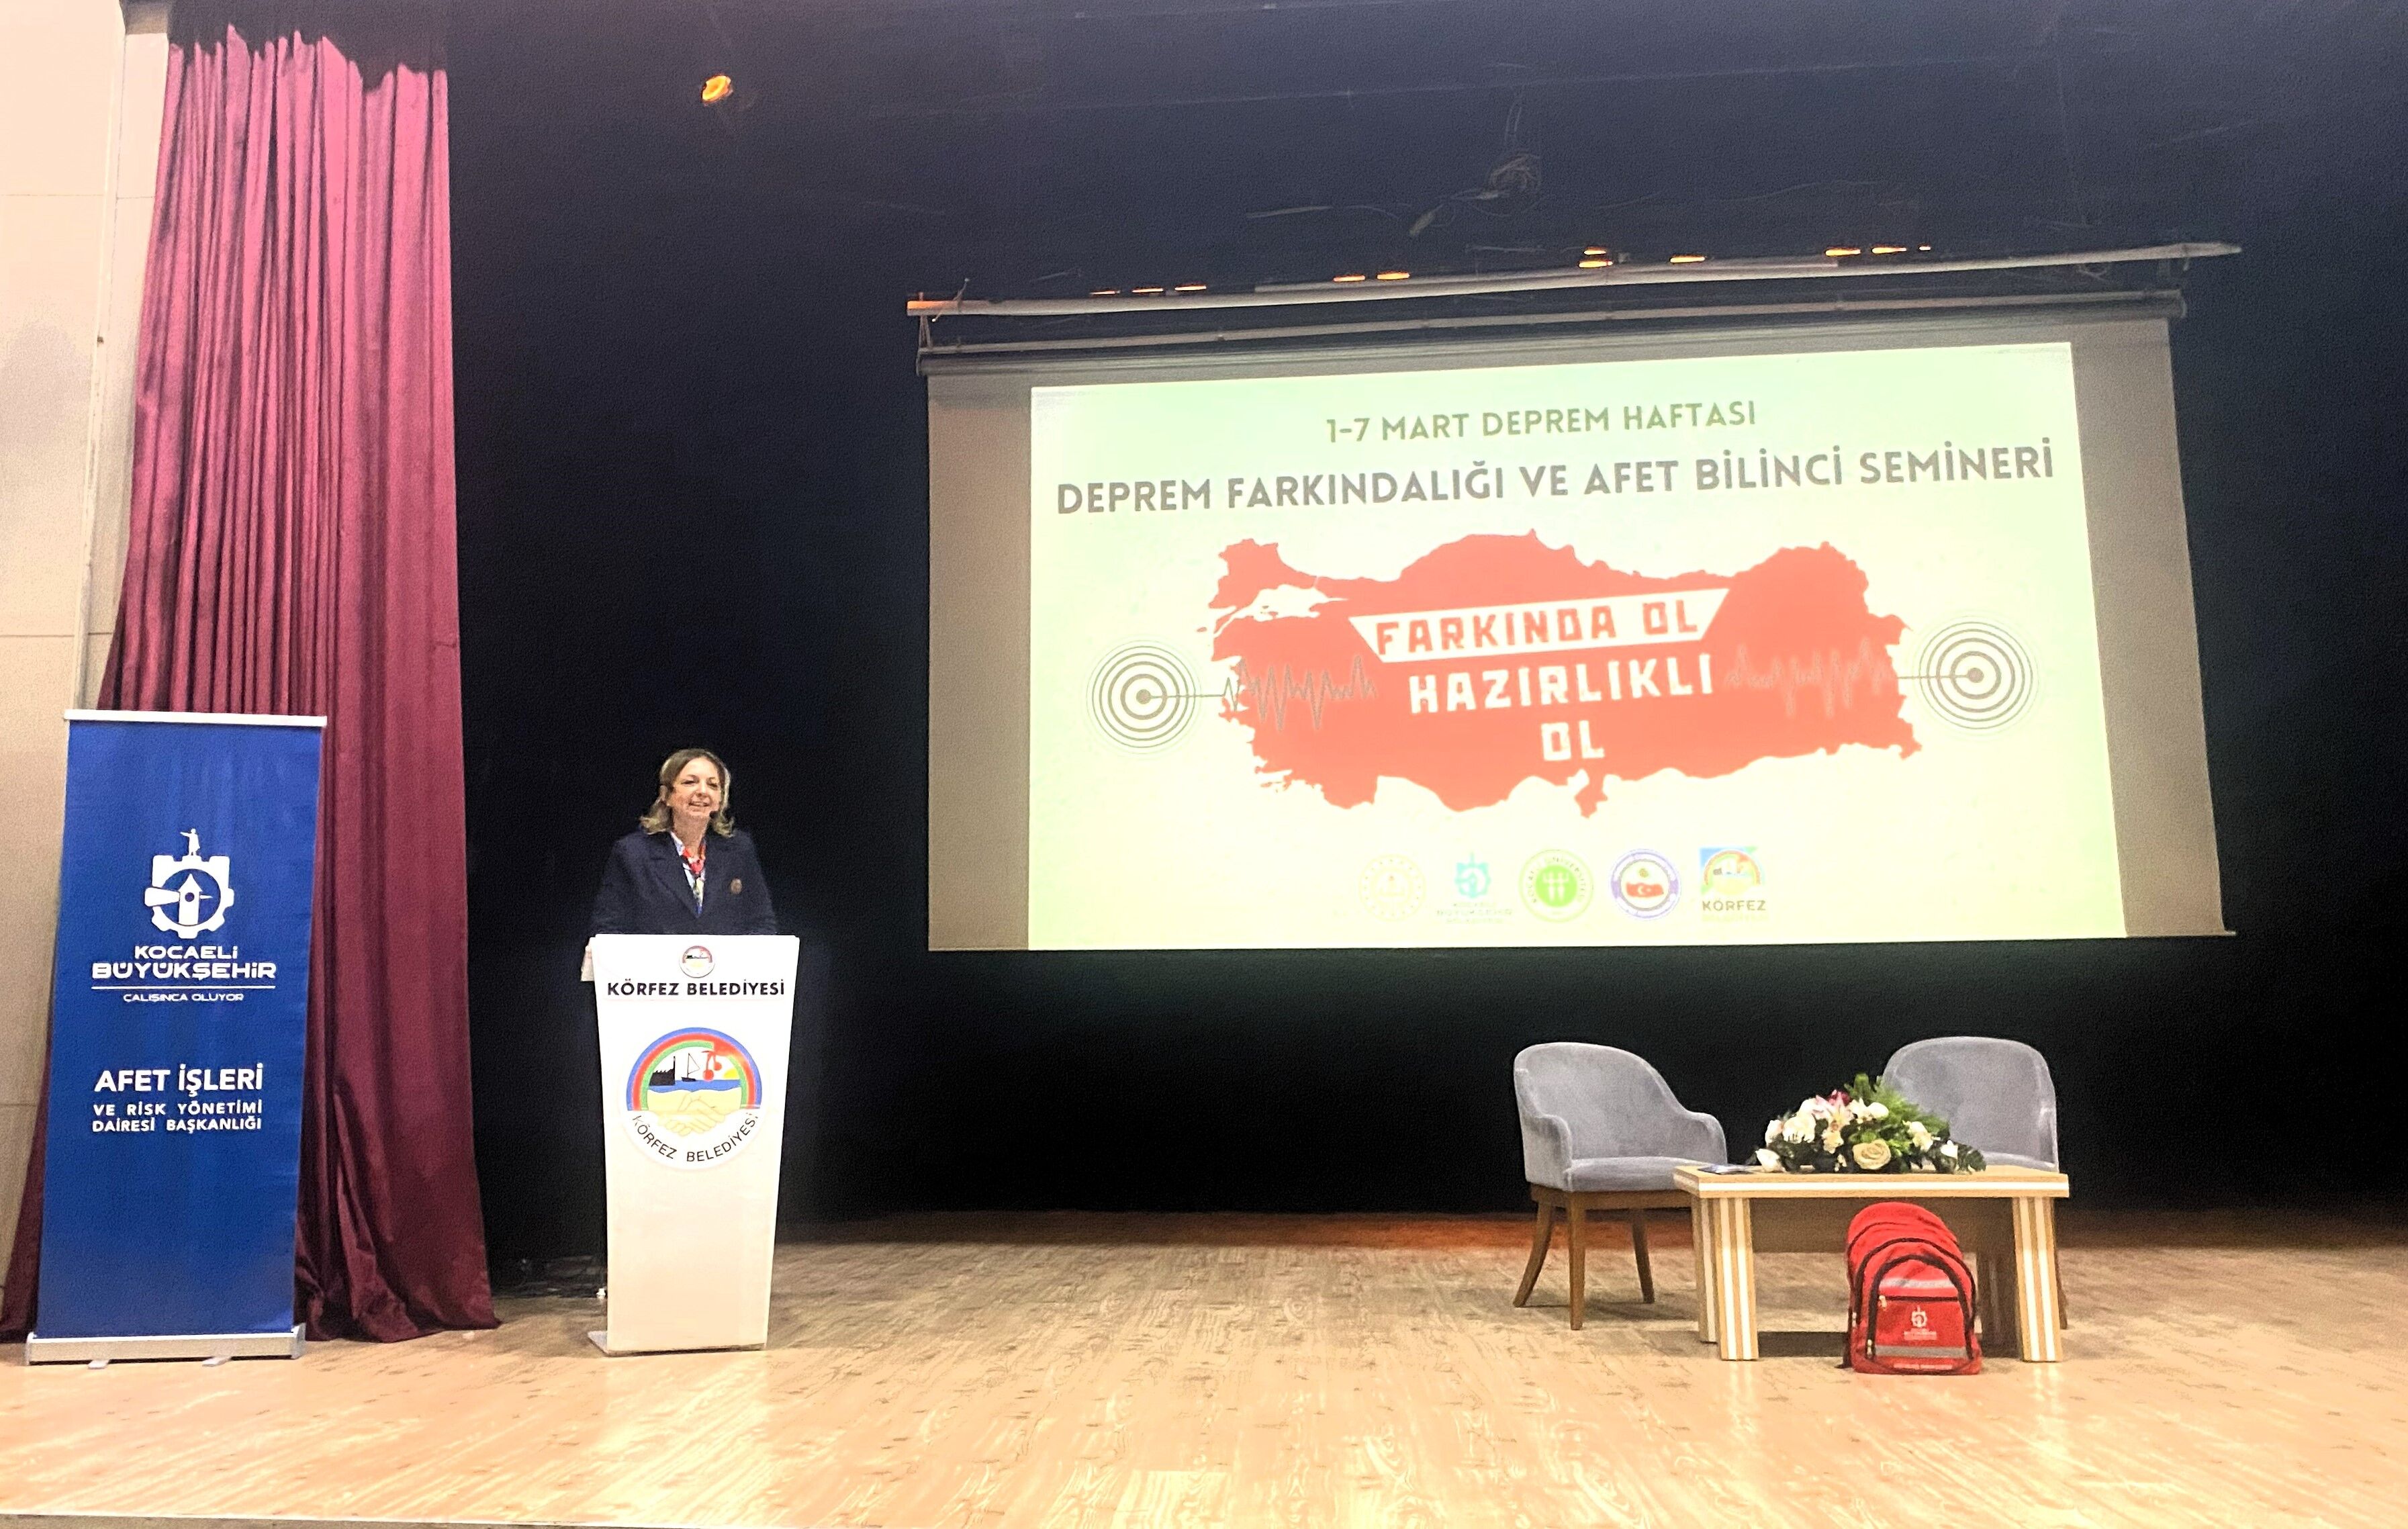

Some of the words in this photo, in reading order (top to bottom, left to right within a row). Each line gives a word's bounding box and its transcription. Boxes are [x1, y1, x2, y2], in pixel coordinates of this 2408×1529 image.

[1326, 417, 1371, 443] 1-7
[1381, 412, 1470, 441] MART
[1482, 406, 1610, 436] DEPREM
[1622, 400, 1757, 430] HAFTASI
[1057, 479, 1211, 514] DEPREM
[1228, 459, 1503, 509] FARKINDALIĞI
[1519, 464, 1569, 498] VE
[1583, 459, 1679, 496] AFET
[1696, 445, 1844, 491] BİLİNCİ
[1859, 436, 2054, 485] SEMİNERİ
[1375, 605, 1616, 655] FARKINDA
[1642, 599, 1698, 635] OL
[1409, 653, 1713, 714] HAZIRLIKLI
[1540, 719, 1605, 761] OL
[191, 992, 244, 1002] OLUYOR
[607, 978, 680, 996] KÖRFEZ
[686, 978, 785, 996] BELEDİYESİ
[94, 1069, 171, 1093] AFET
[178, 1062, 264, 1097] İŞLERİ
[92, 1117, 155, 1133] DAİRESİ
[166, 1117, 262, 1133] BAŞKANLIĞI
[93, 1104, 115, 1117] VE
[126, 1101, 166, 1115] RİSK
[177, 1099, 263, 1115] YÖNETİMİ
[632, 1115, 678, 1160] KÖRFEZ
[686, 1112, 759, 1162] BELEDİYESİ
